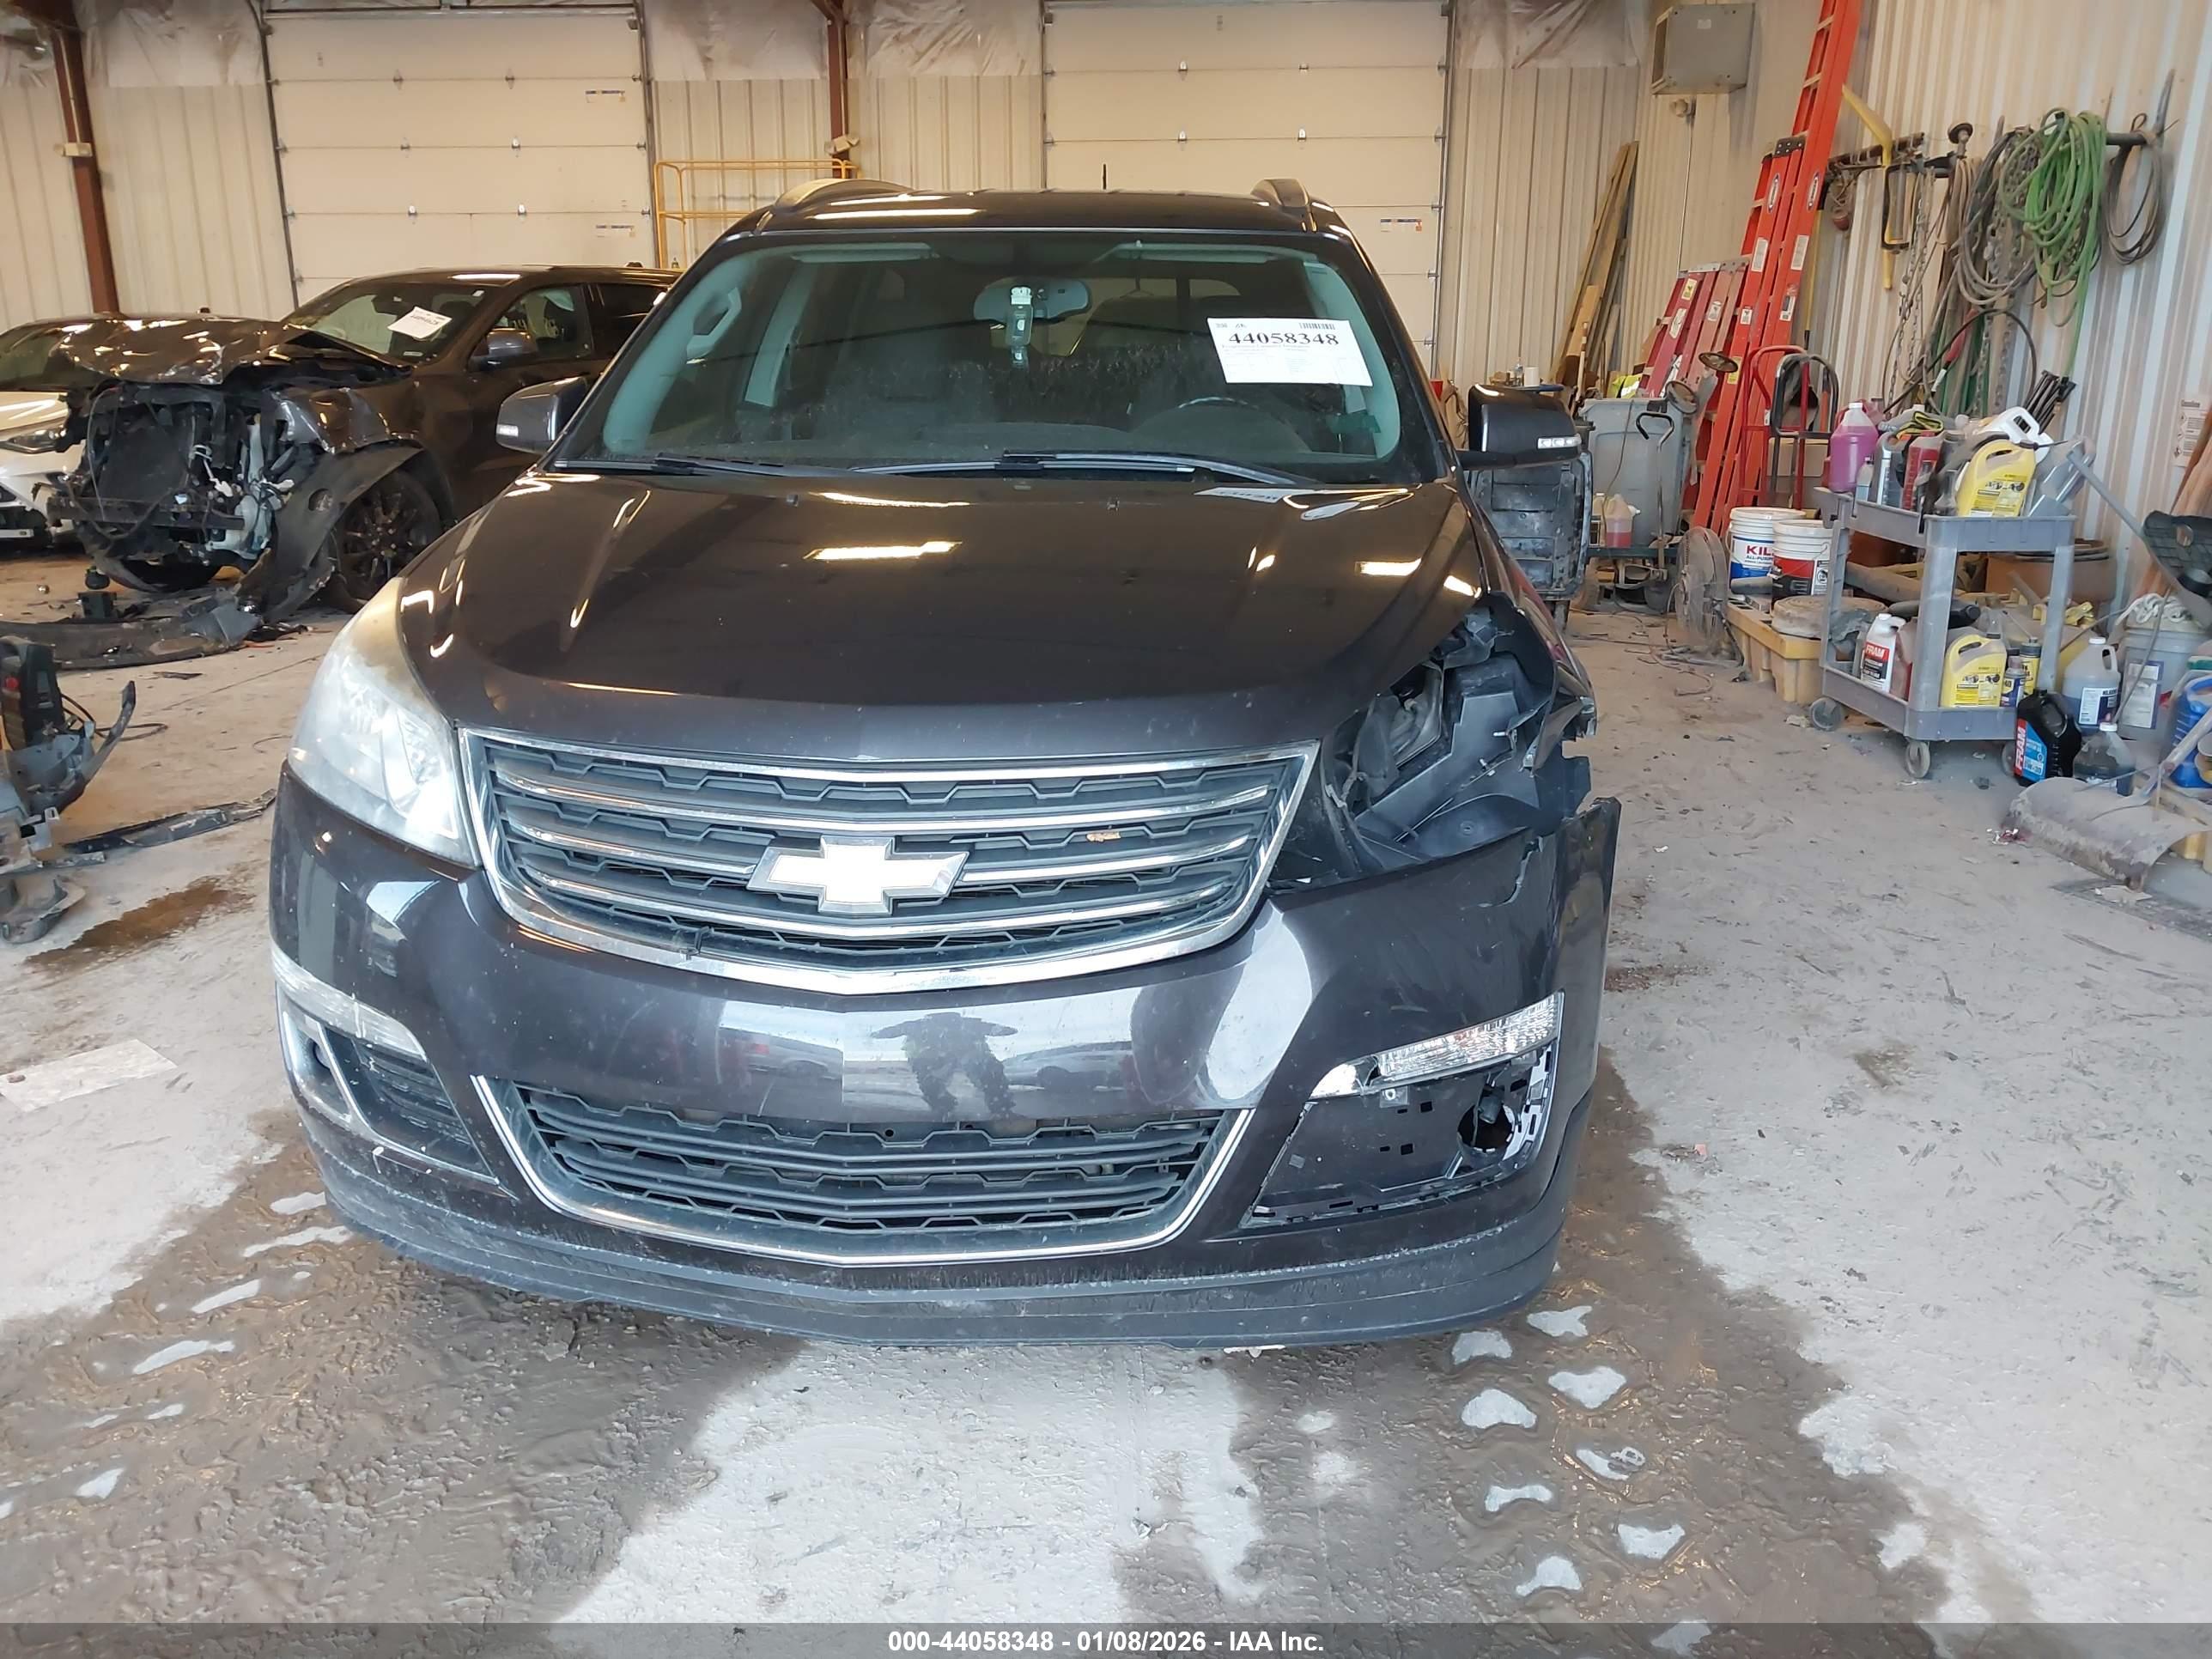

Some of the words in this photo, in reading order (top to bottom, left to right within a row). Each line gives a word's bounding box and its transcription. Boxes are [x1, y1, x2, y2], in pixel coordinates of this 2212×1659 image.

[1229, 332, 1340, 345] 44058348
[1747, 545, 1775, 556] KIL
[1866, 644, 1886, 657] FRAM
[2015, 727, 2026, 770] FRAM
